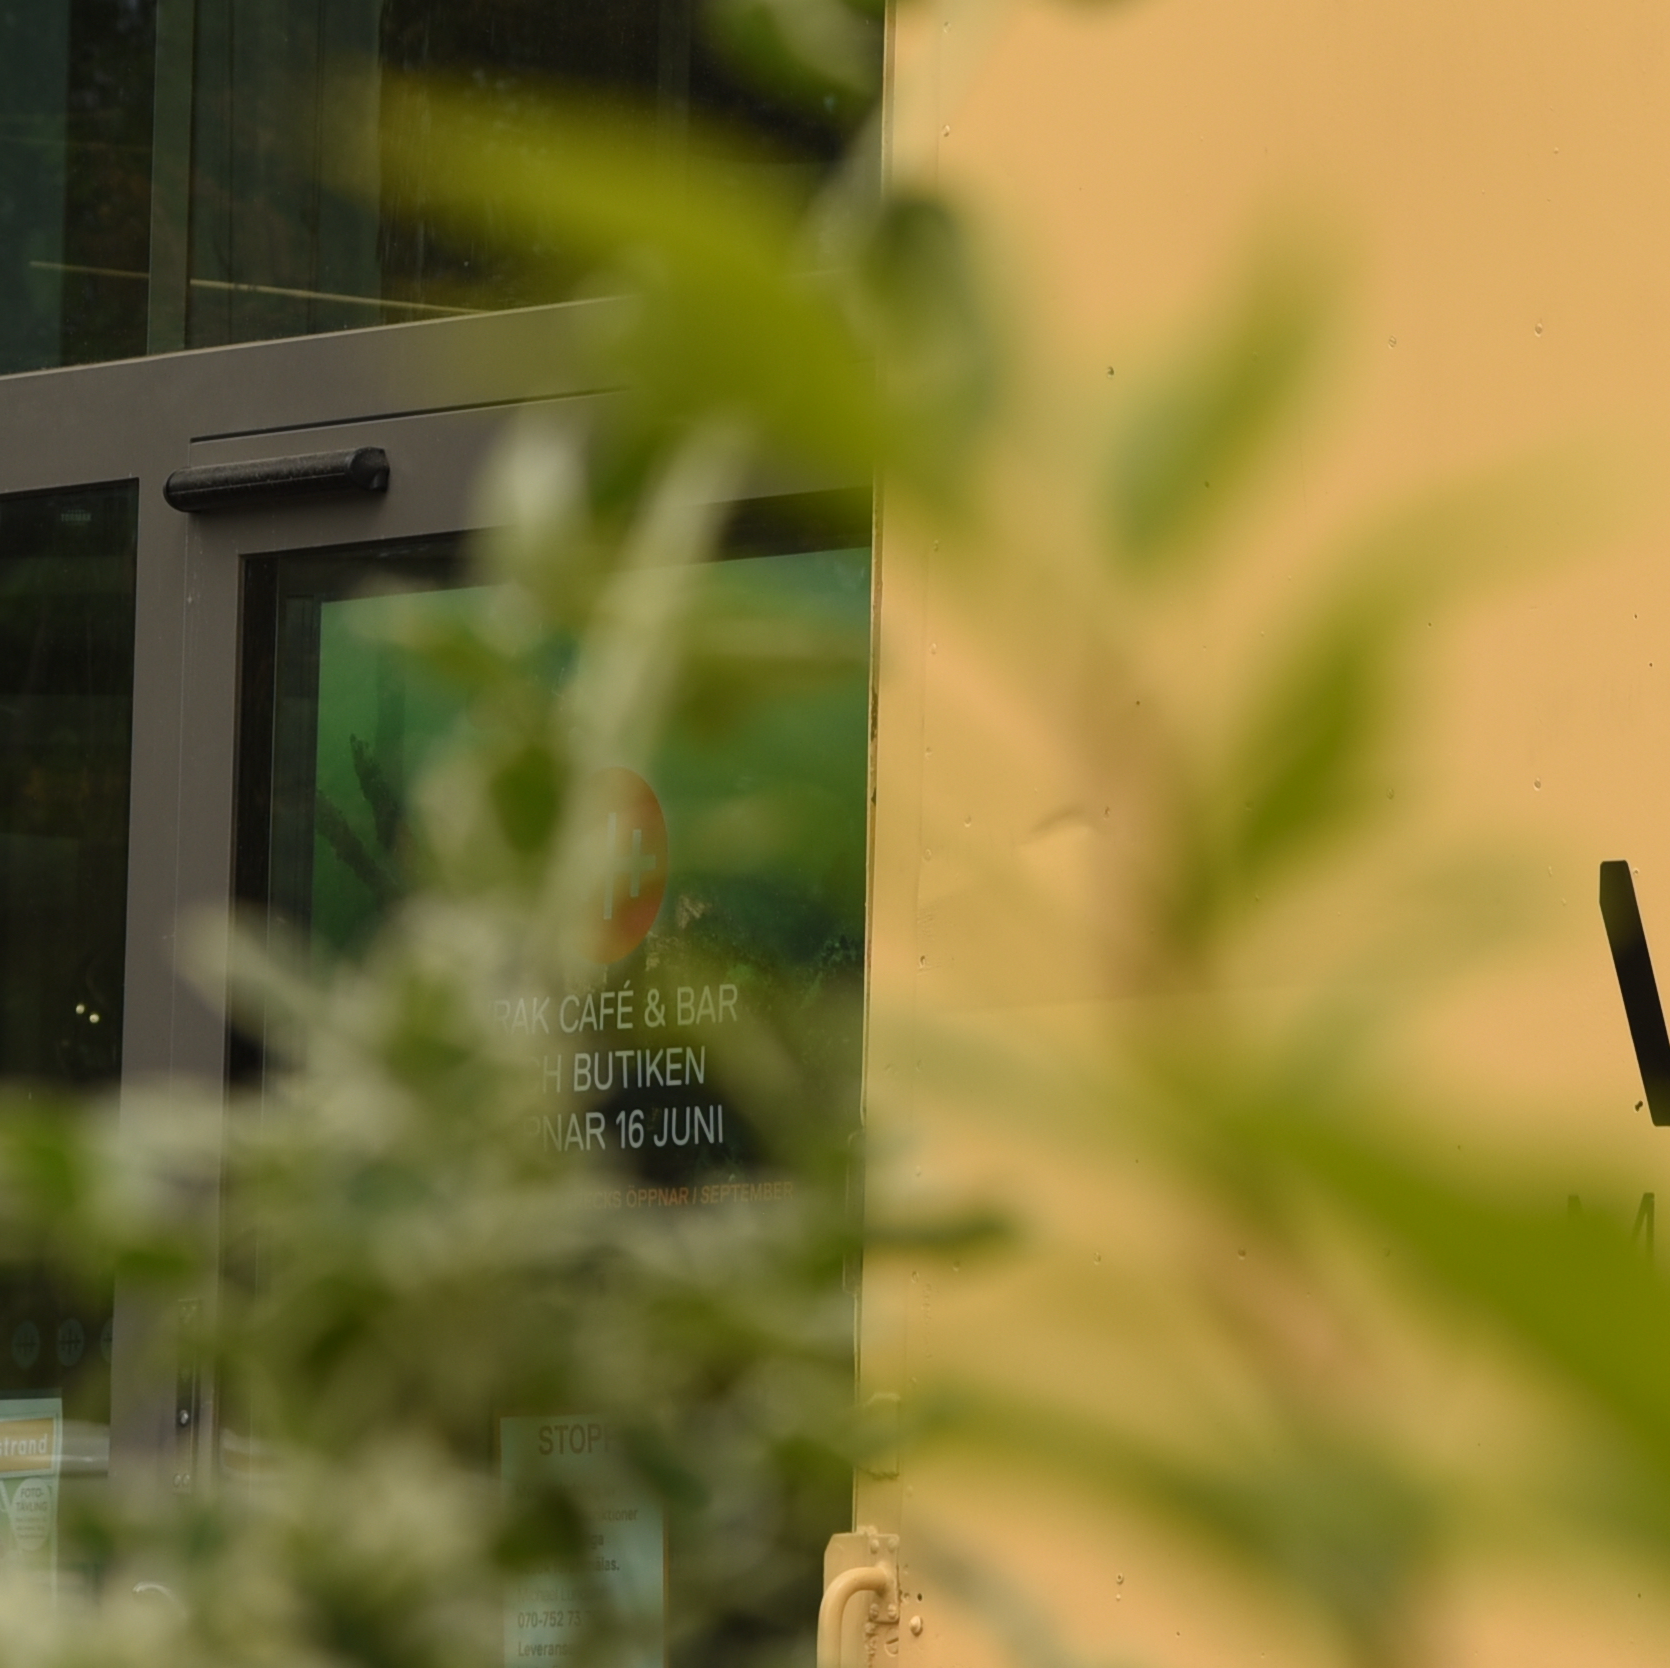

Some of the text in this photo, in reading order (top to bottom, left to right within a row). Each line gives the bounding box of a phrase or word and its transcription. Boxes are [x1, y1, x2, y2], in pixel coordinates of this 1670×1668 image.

[486, 979, 739, 1035] RAK CAFÉ & BAR
[573, 1045, 706, 1093] BUTIKEN
[522, 1104, 724, 1152] PNAR 16 JUNI
[626, 1184, 690, 1208] ÖPPNAR
[699, 1181, 794, 1206] SEPTEMBER
